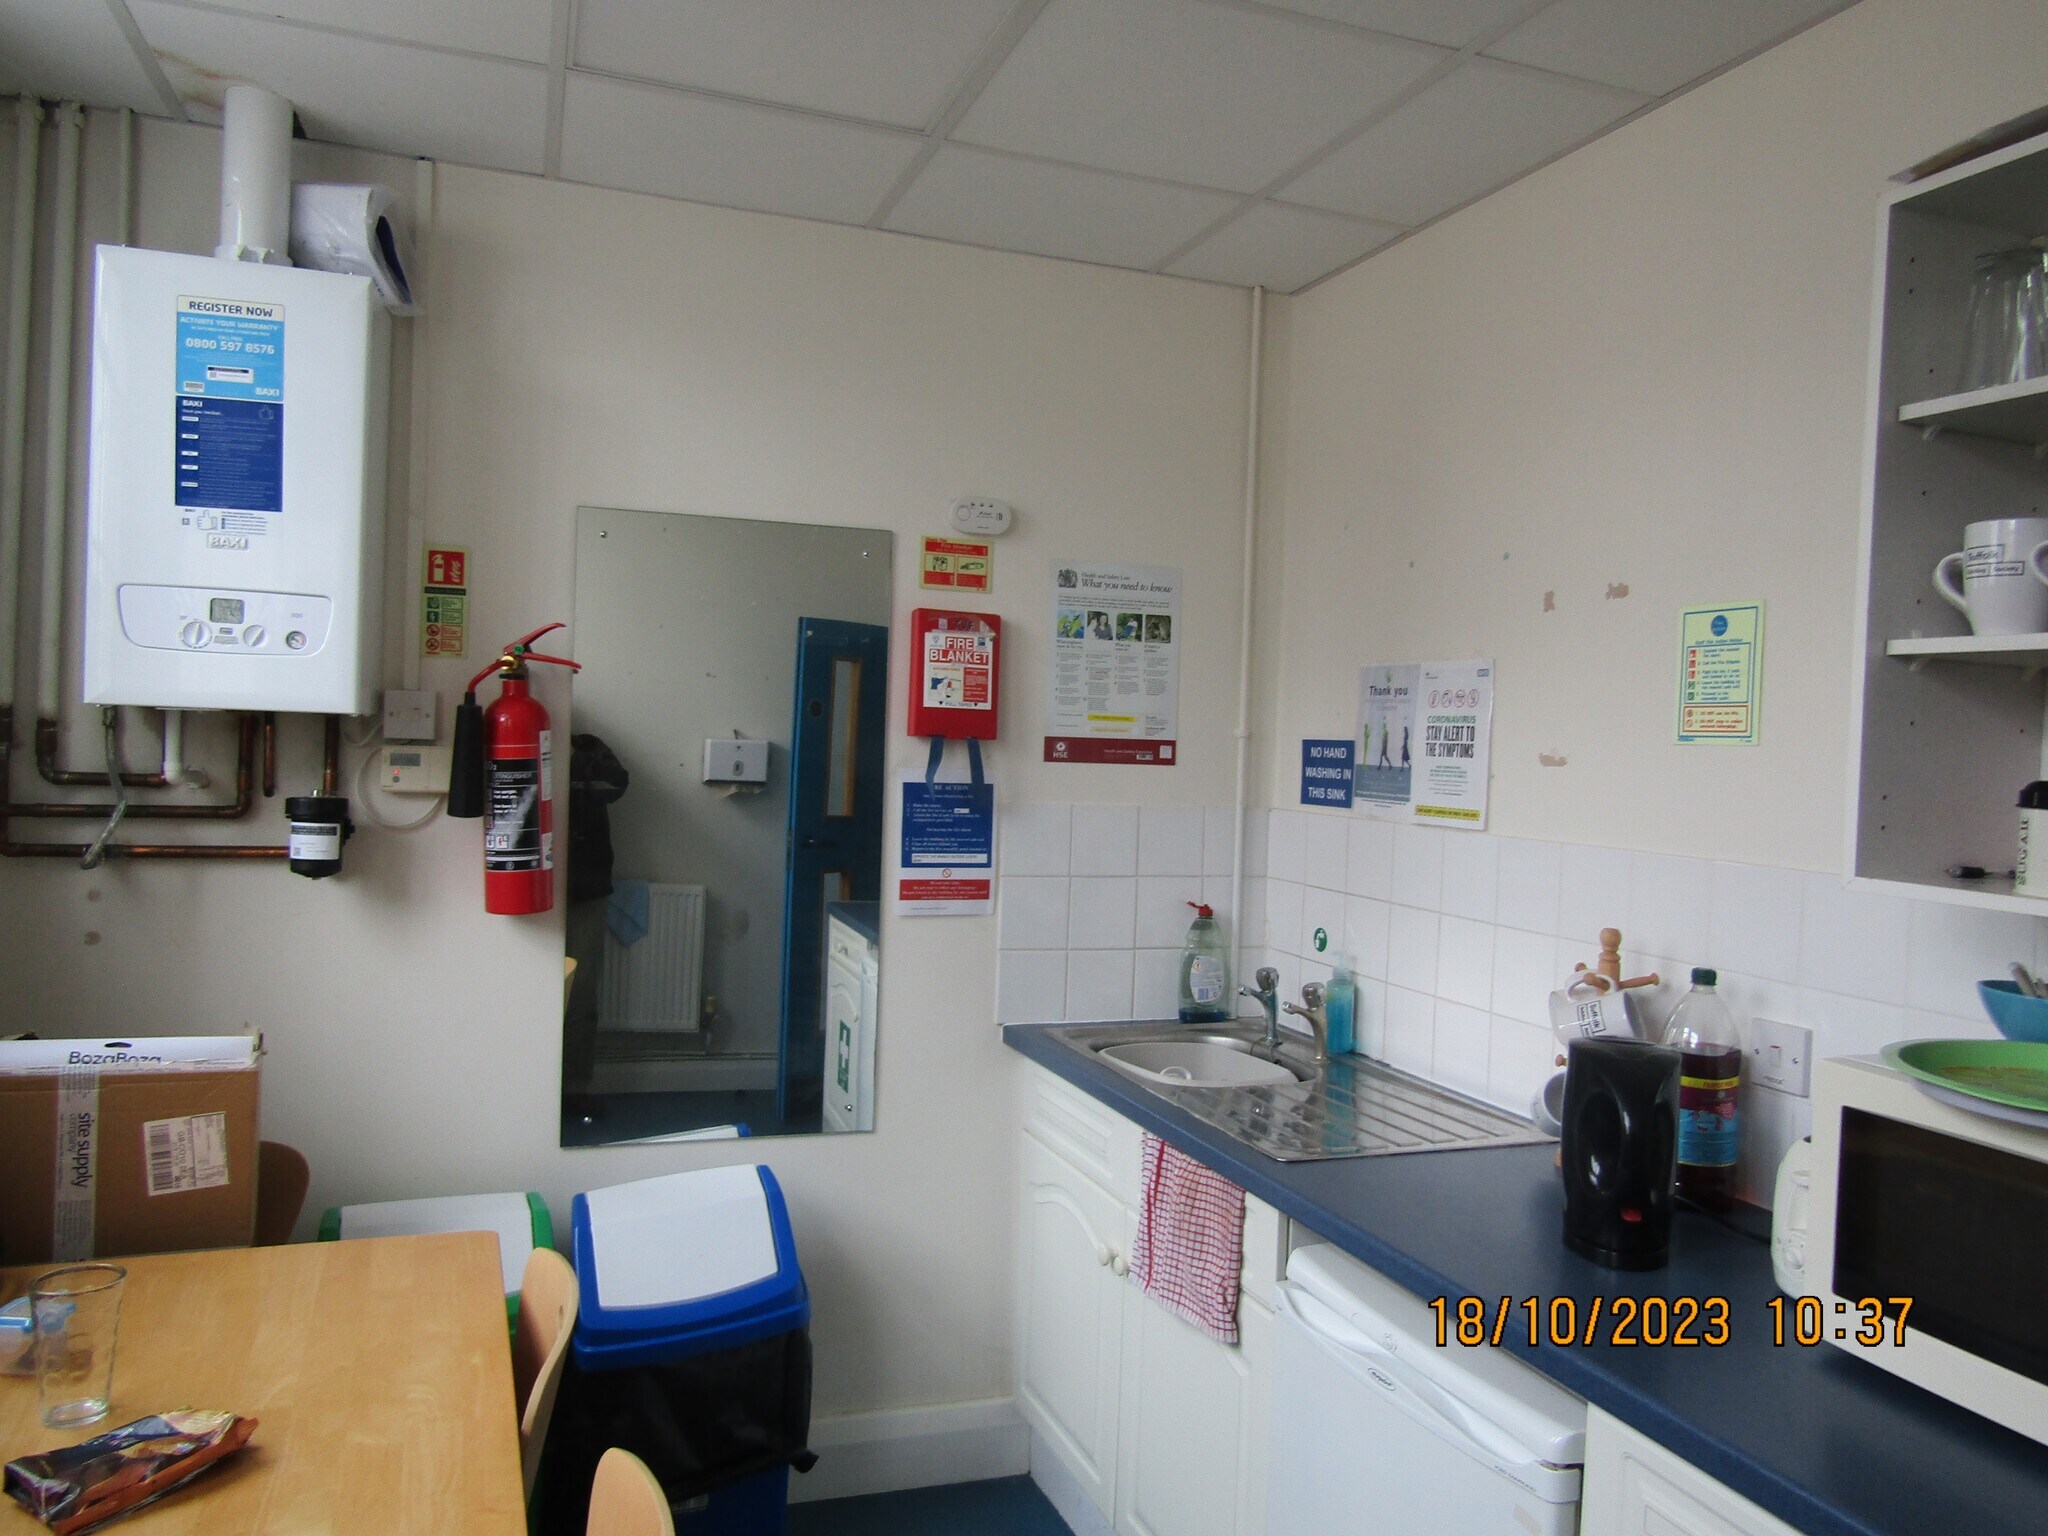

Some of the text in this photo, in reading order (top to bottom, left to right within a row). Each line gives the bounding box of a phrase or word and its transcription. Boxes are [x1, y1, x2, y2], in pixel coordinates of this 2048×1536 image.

[189, 301, 274, 318] REGISTER NOW
[185, 337, 217, 350] 0800
[220, 340, 242, 352] 597
[255, 387, 280, 397] BAXI
[182, 399, 203, 408] BAXI
[210, 535, 249, 549] BAXI
[1081, 578, 1173, 593] What you need to know
[946, 637, 974, 650] FIRE
[930, 649, 989, 664] BLANKET
[1369, 685, 1409, 698] Thank you
[1426, 715, 1477, 724] CORONAVIRUS
[1426, 725, 1475, 742] STAY ALERT TO
[1052, 751, 1068, 759] HSE
[1310, 746, 1347, 759] NO HAND
[1425, 742, 1475, 758] THE SYMPTOMS
[1305, 766, 1351, 780] WASHING IN
[1307, 786, 1346, 801] THIS SINK
[2017, 817, 2029, 886] SUGAR
[68, 1051, 162, 1065] BozaBoza
[78, 1112, 95, 1138] site
[71, 1141, 94, 1188] supply
